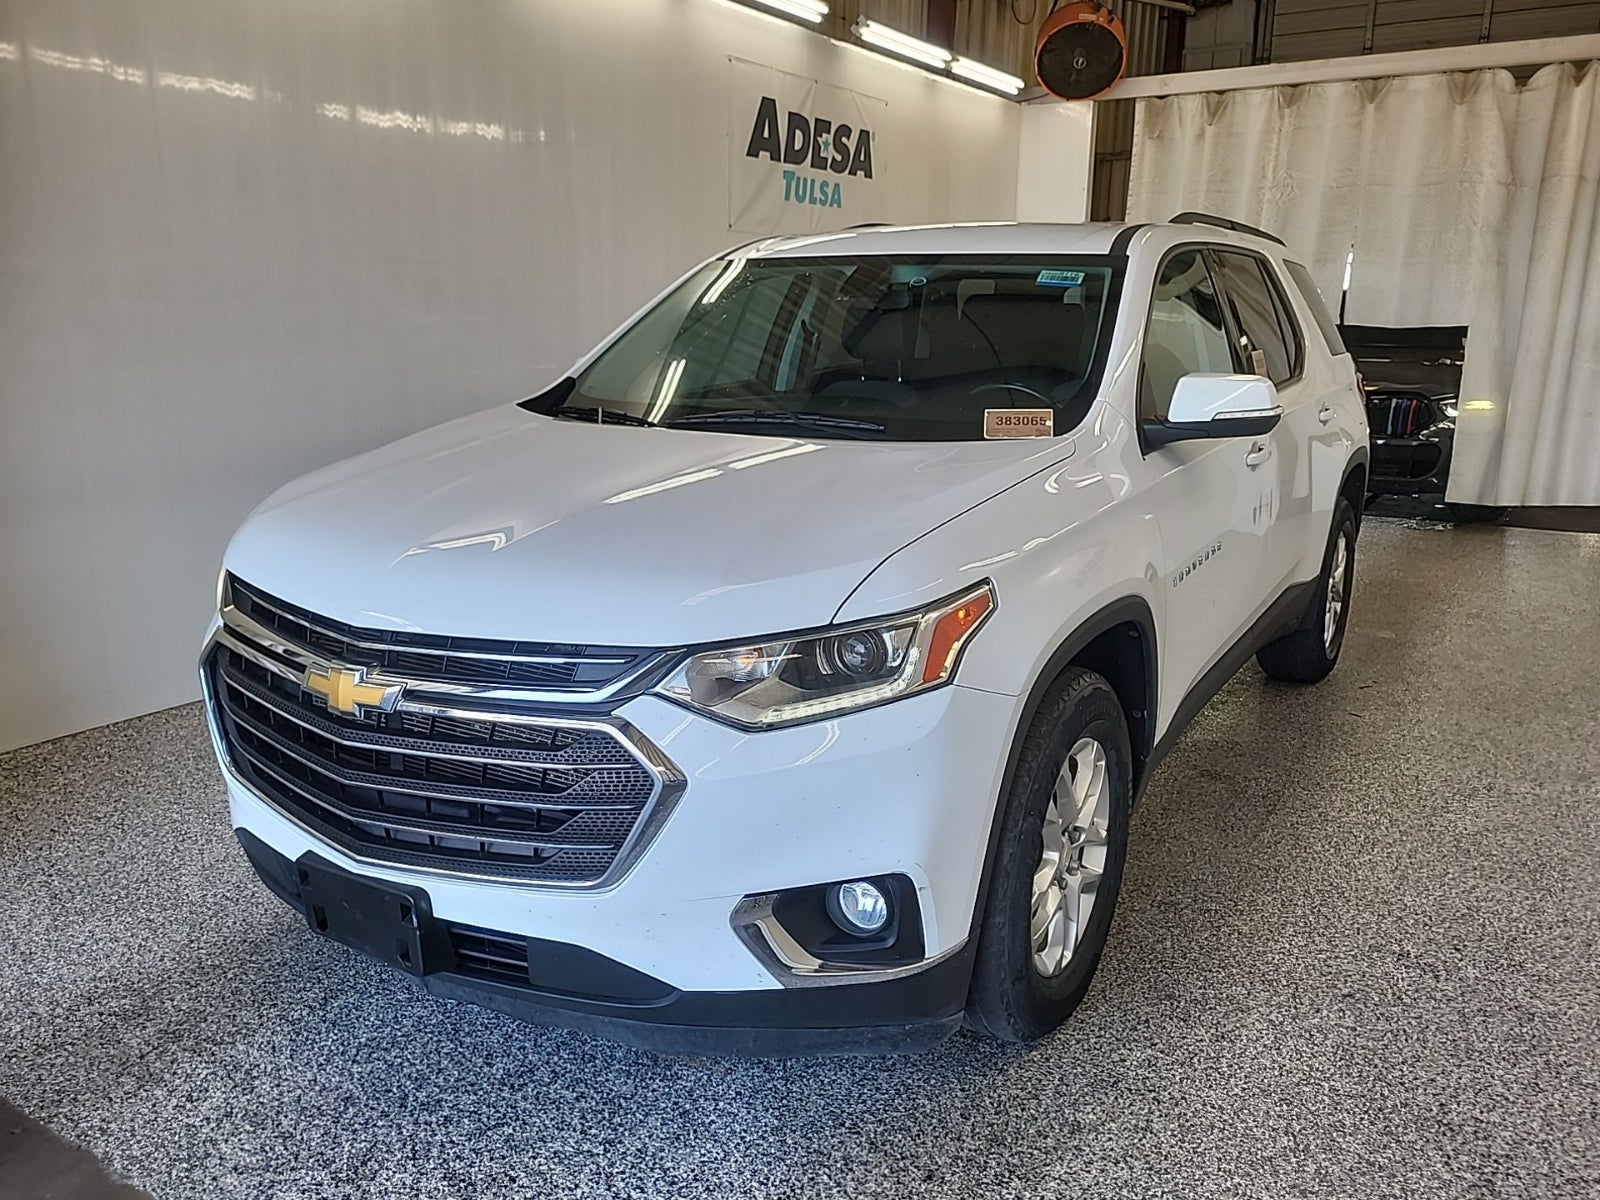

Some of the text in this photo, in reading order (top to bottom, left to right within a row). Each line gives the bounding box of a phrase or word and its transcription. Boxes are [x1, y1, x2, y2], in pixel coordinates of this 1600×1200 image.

[746, 96, 873, 179] ADESA
[783, 170, 842, 208] TULSA
[996, 416, 1047, 426] 383065
